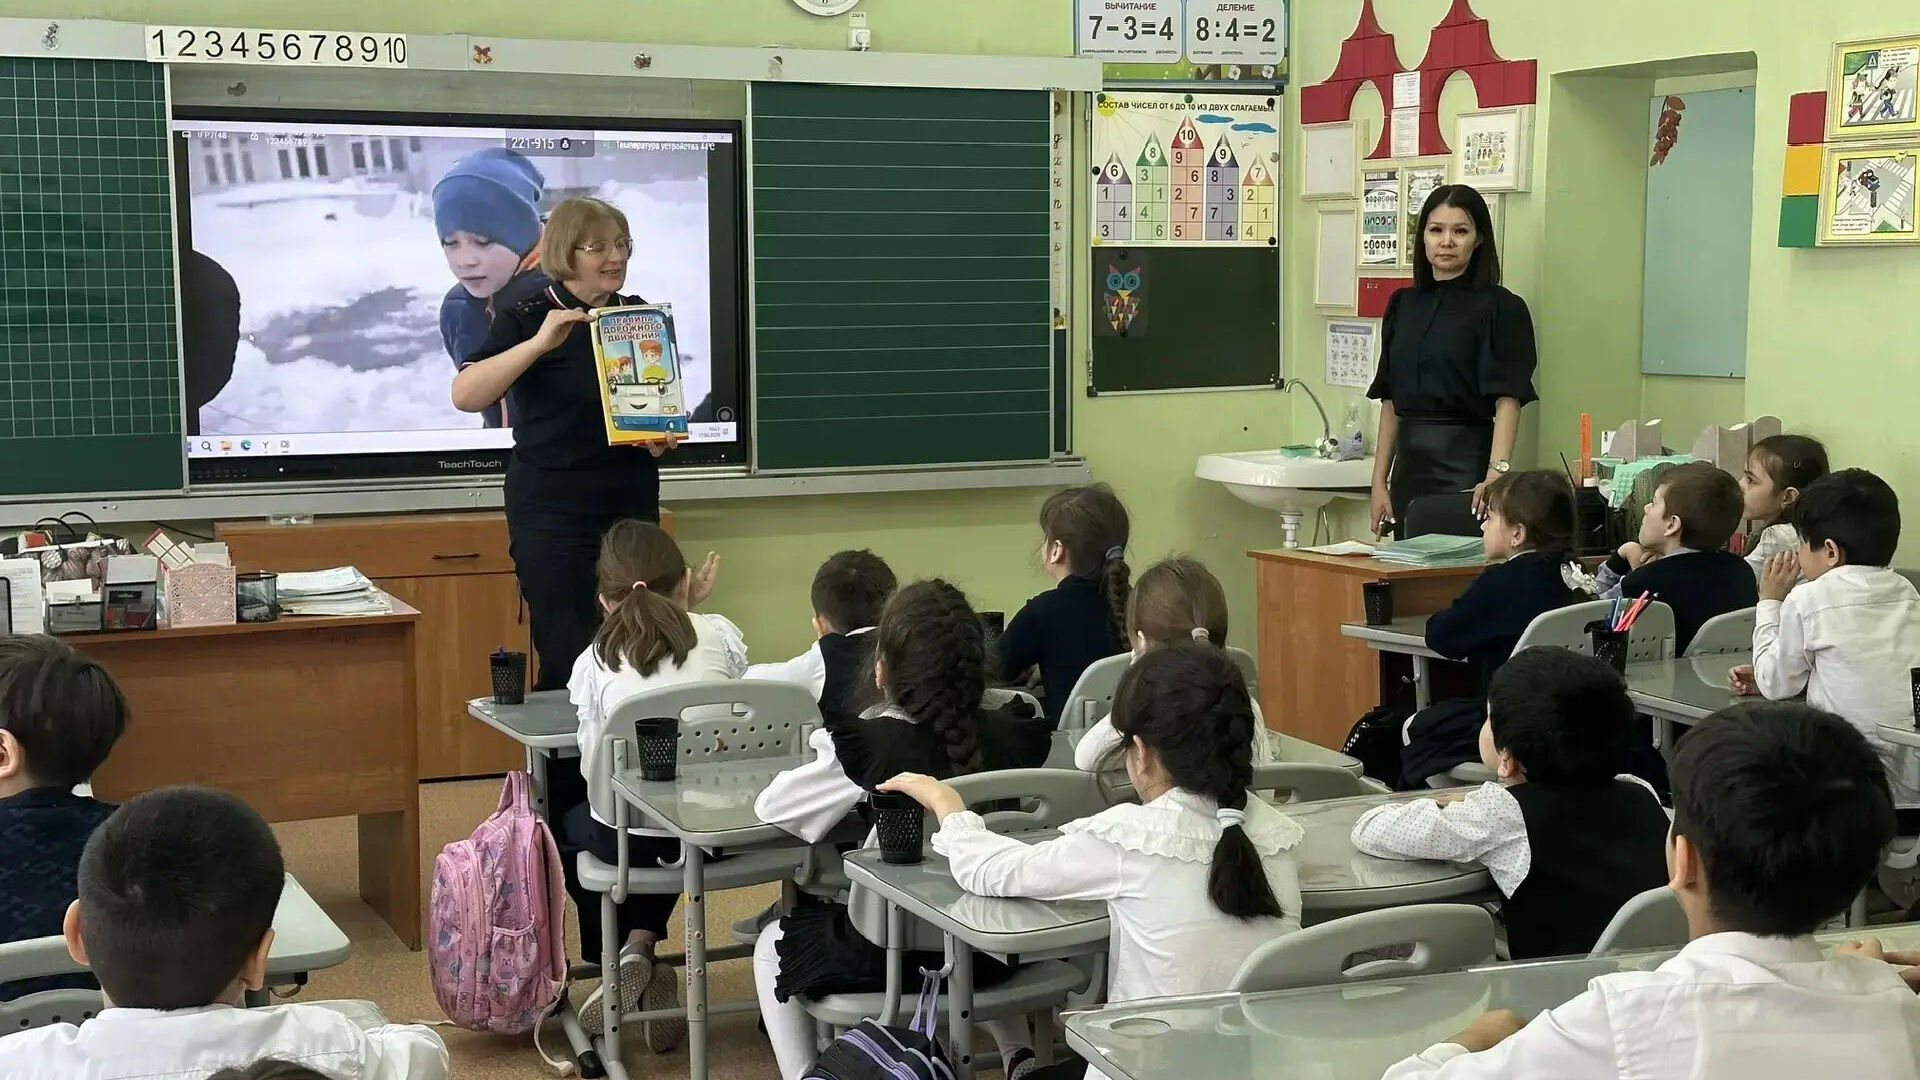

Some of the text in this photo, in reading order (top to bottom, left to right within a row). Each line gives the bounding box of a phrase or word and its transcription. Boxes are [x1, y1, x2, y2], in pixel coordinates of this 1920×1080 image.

[1105, 2, 1156, 11] ВЫЧИТАНИЕ
[1216, 3, 1255, 12] ДЕЛЕНИЕ
[1097, 101, 1129, 109] СОСТАВ
[1131, 102, 1158, 110] ЧИСЕЛ
[1175, 103, 1186, 111] ДО
[1187, 103, 1196, 111] 10
[1197, 103, 1208, 111] ИЗ
[1209, 104, 1229, 112] ДВУХ
[1230, 104, 1275, 112] СЛАГАЕМЫХ
[1181, 129, 1194, 141] 10
[511, 137, 555, 150] 221-915
[1149, 147, 1156, 159] 8
[1175, 151, 1183, 164] 9
[1220, 148, 1227, 160] 9
[1111, 165, 1119, 177] 6
[1141, 169, 1149, 181] 3
[1191, 170, 1199, 182] 6
[1211, 170, 1219, 182] 8
[1254, 167, 1262, 178] 7
[1102, 188, 1109, 200] 1
[1157, 188, 1162, 200] 1
[1175, 188, 1182, 200] 2
[1226, 188, 1234, 201] 3
[1246, 189, 1254, 201] 2
[1118, 206, 1128, 218] 4
[1140, 206, 1148, 218] 4
[1190, 207, 1198, 219] 7
[1210, 207, 1218, 219] 7
[1262, 207, 1268, 219] 1
[1101, 224, 1109, 237] 3
[1155, 225, 1163, 236] 6
[1175, 225, 1182, 237] 5
[1225, 225, 1234, 237] 4
[1245, 224, 1254, 237] 4
[609, 315, 654, 324] ПРАВИЛА
[603, 323, 662, 334] ДОРОЖНОГО
[608, 332, 661, 342] ДВИЖЕНИЯ
[438, 460, 502, 469] TeachTouch
